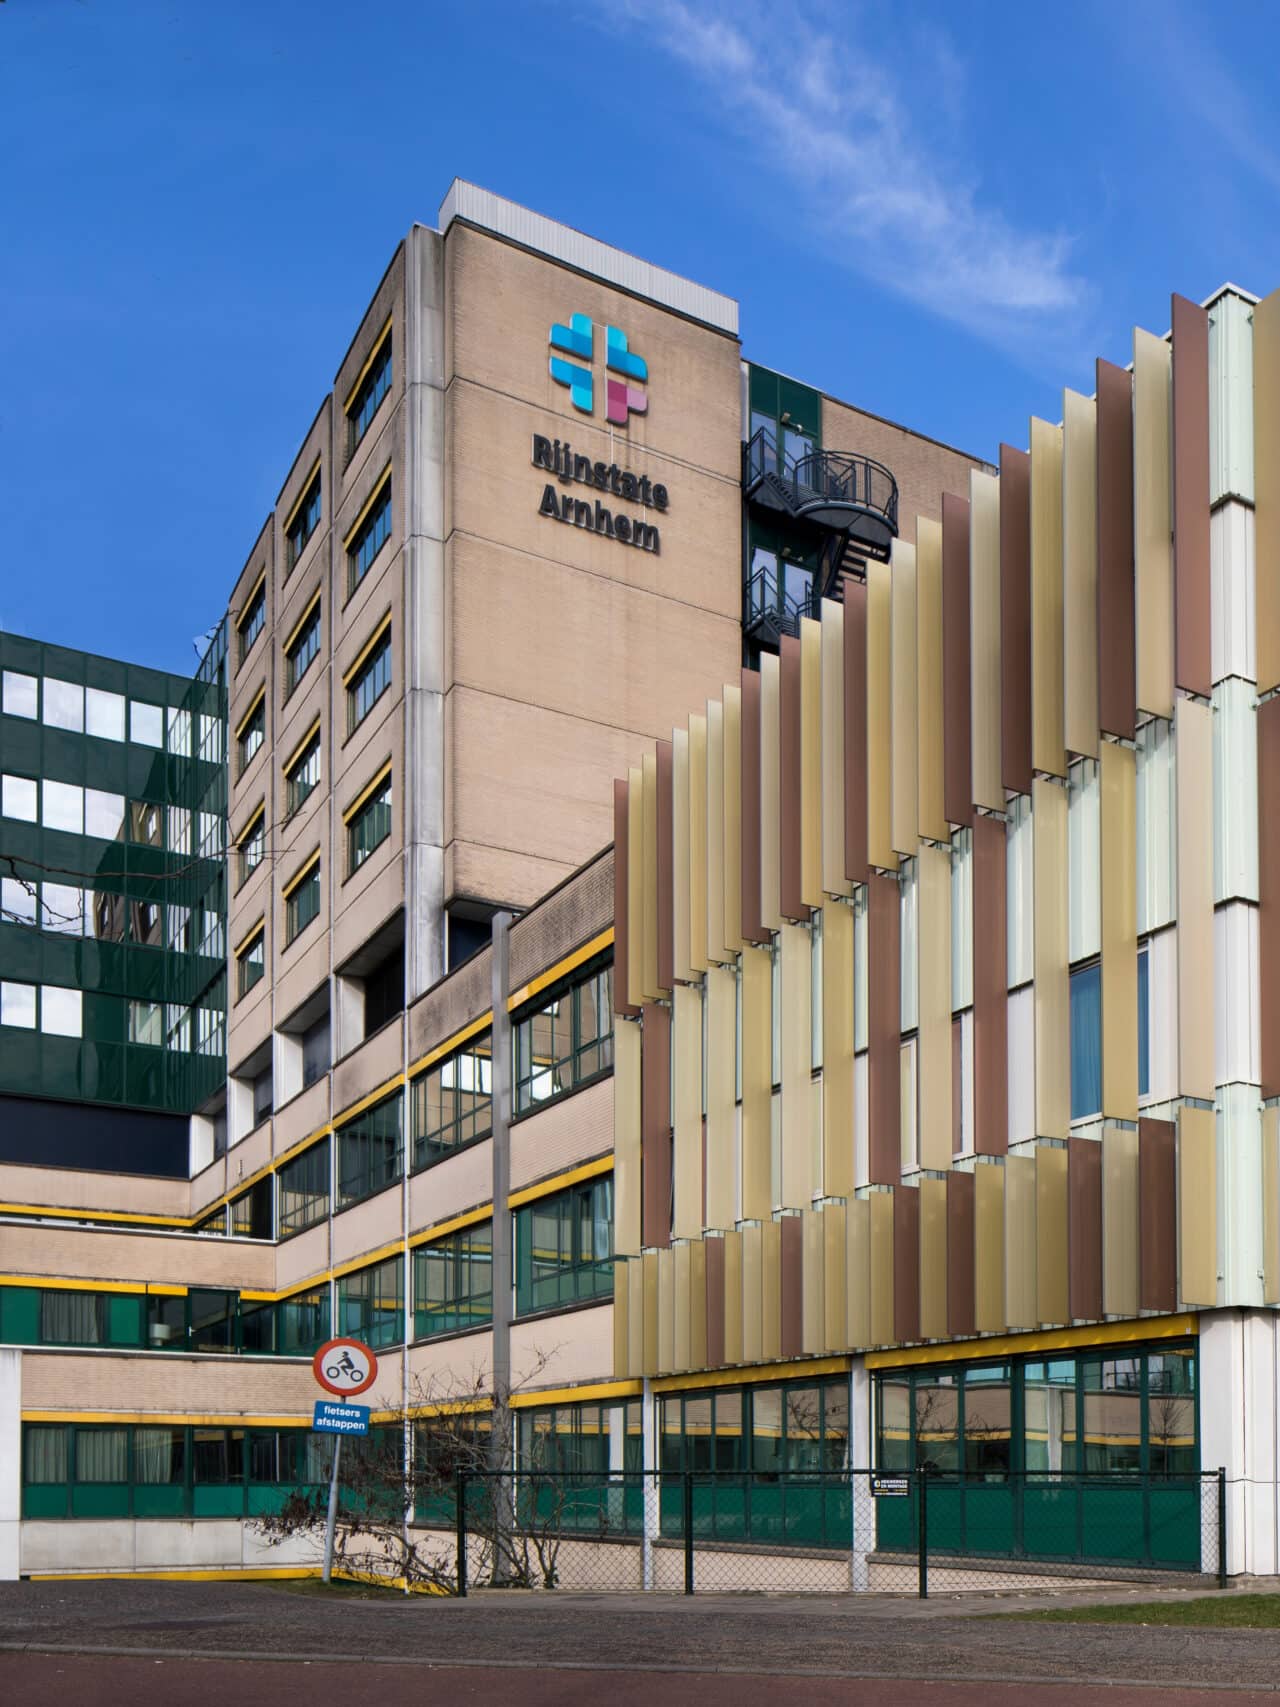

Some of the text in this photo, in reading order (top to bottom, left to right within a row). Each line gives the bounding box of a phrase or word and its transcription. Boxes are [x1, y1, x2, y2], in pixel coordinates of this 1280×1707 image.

[531, 433, 669, 513] Rijnstate
[538, 484, 661, 555] Arnhem
[316, 1417, 365, 1430] afstappen
[324, 1405, 361, 1417] fietsers
